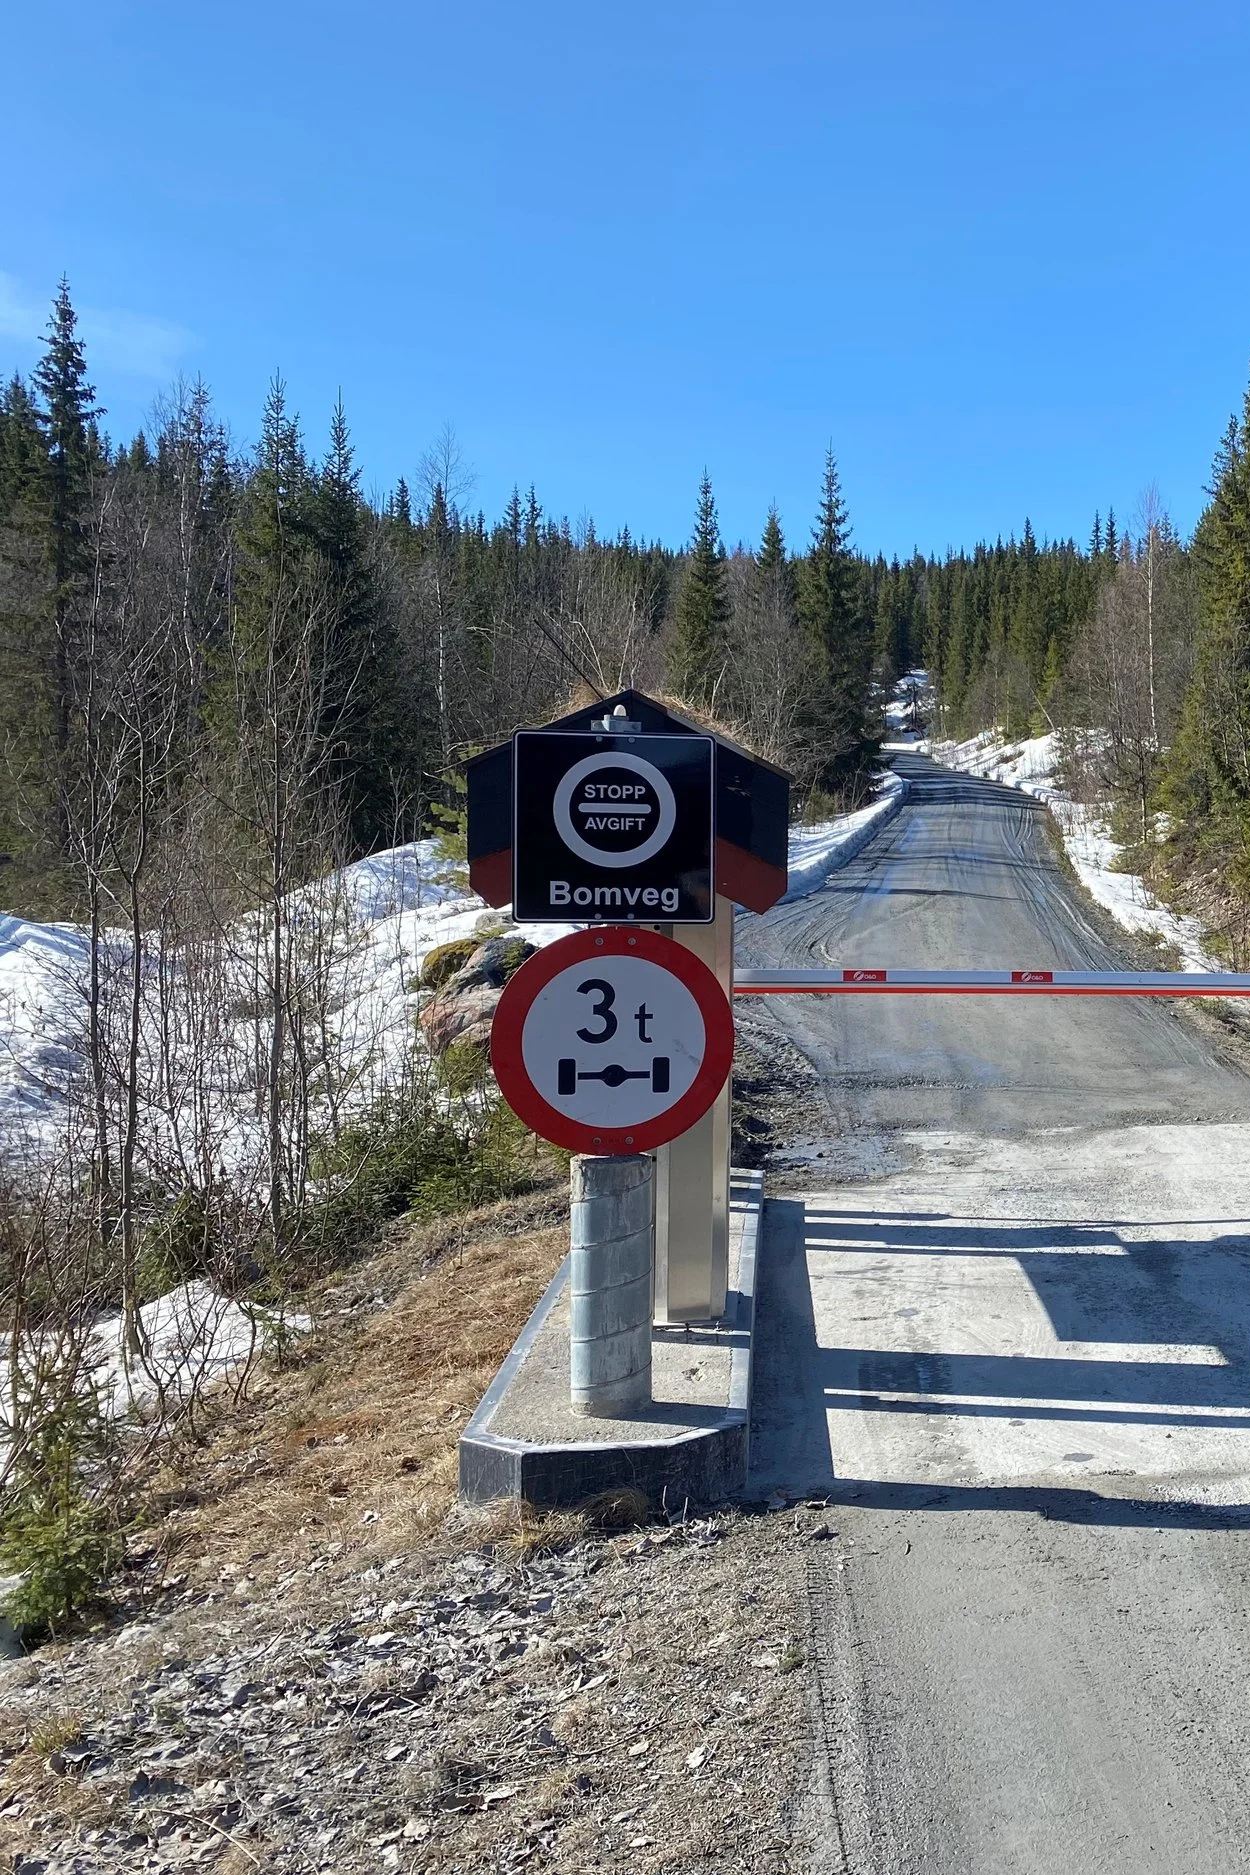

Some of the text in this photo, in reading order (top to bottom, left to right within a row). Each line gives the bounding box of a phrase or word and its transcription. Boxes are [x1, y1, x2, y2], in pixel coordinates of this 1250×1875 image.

[584, 784, 646, 799] STOPP
[584, 817, 646, 831] AVGIFT
[549, 880, 679, 912] Bomveg
[576, 978, 654, 1044] 3 t
